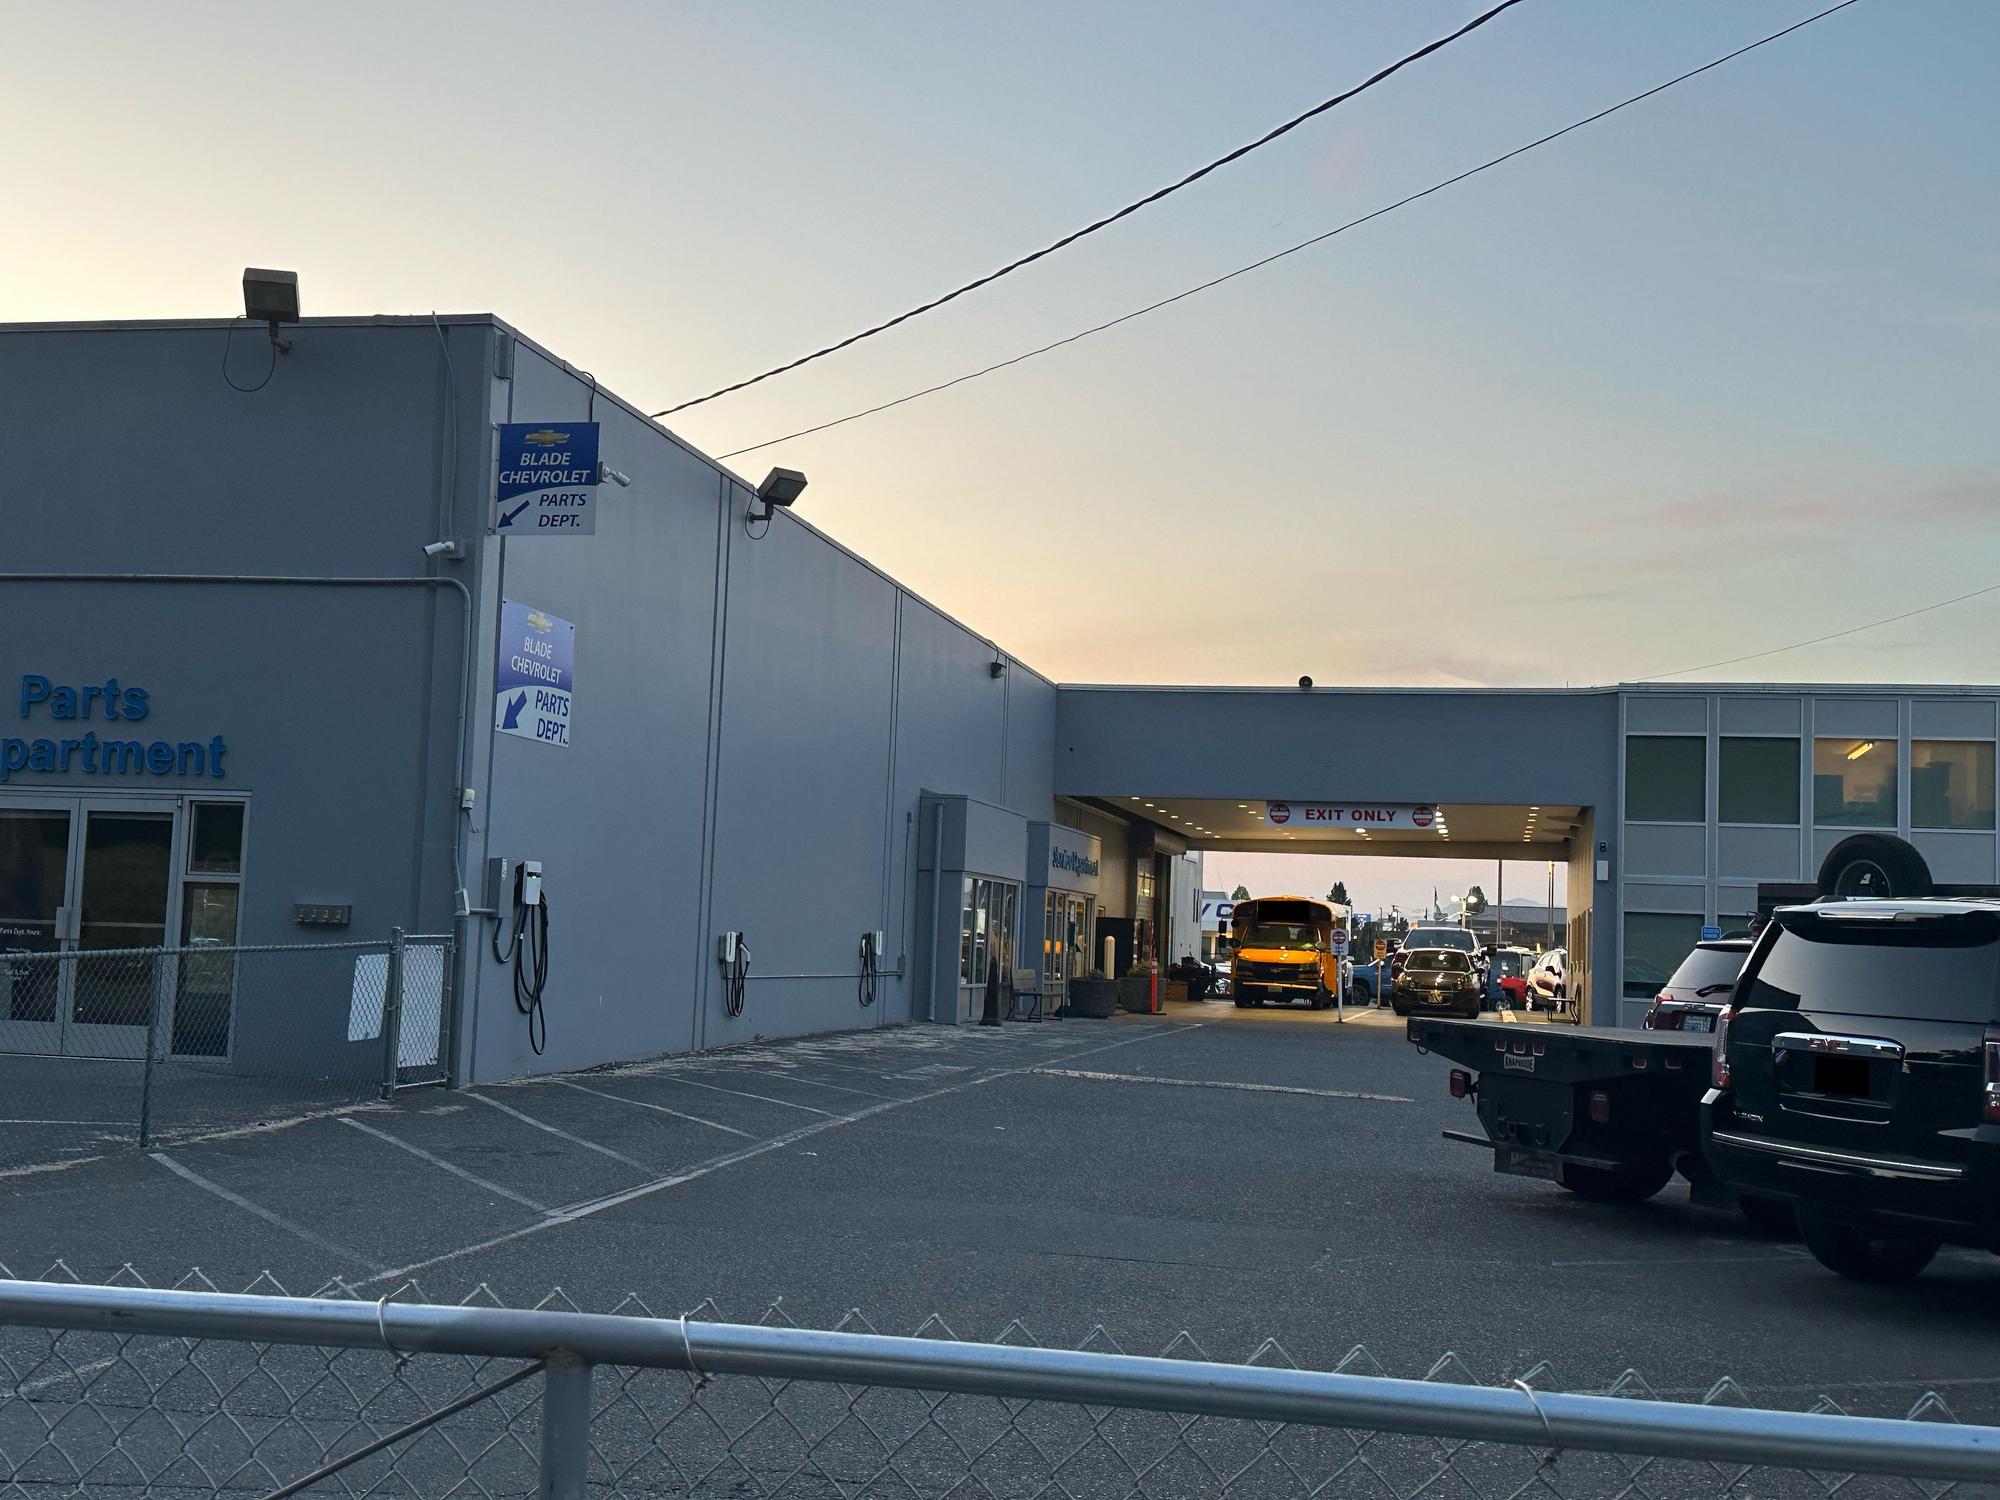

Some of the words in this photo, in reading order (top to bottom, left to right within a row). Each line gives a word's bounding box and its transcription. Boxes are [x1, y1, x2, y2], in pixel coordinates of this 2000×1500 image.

[520, 452, 571, 466] BLADE
[499, 470, 591, 484] CHEVROLET
[539, 493, 587, 507] PARTS
[538, 514, 580, 527] DEPT.
[523, 636, 553, 660] BLADE
[511, 655, 562, 684] CHEVROLET
[20, 674, 150, 720] Parts
[535, 689, 569, 717] PARTS
[536, 718, 567, 745] DEPT.
[0, 731, 227, 781] partment
[1305, 808, 1344, 821] EXIT
[1351, 809, 1396, 822] ONLY
